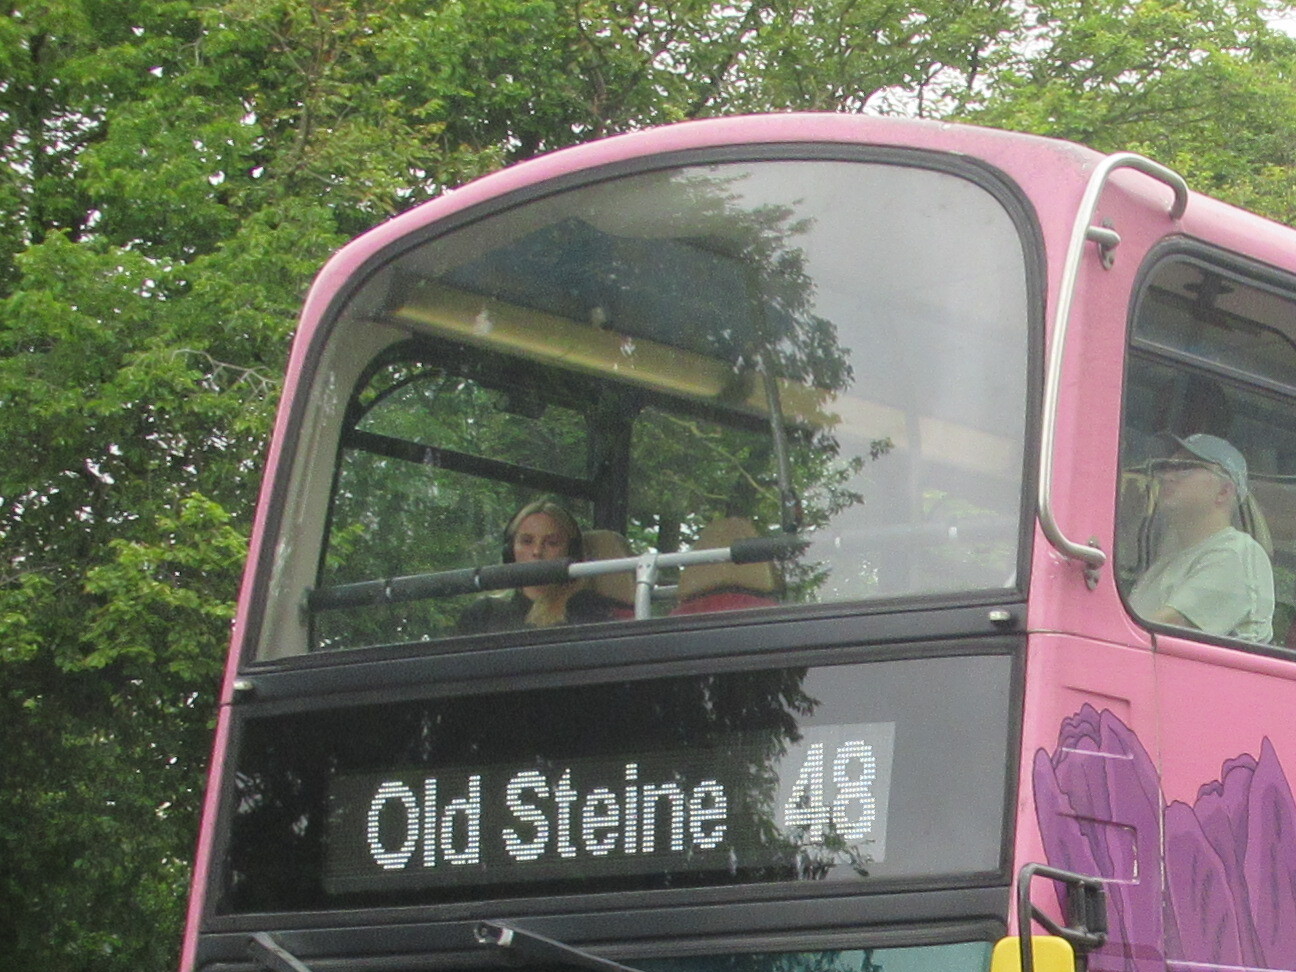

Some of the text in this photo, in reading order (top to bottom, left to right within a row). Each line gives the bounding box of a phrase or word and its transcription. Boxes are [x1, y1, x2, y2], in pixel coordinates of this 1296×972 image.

[367, 740, 877, 869] Old Steine 48
